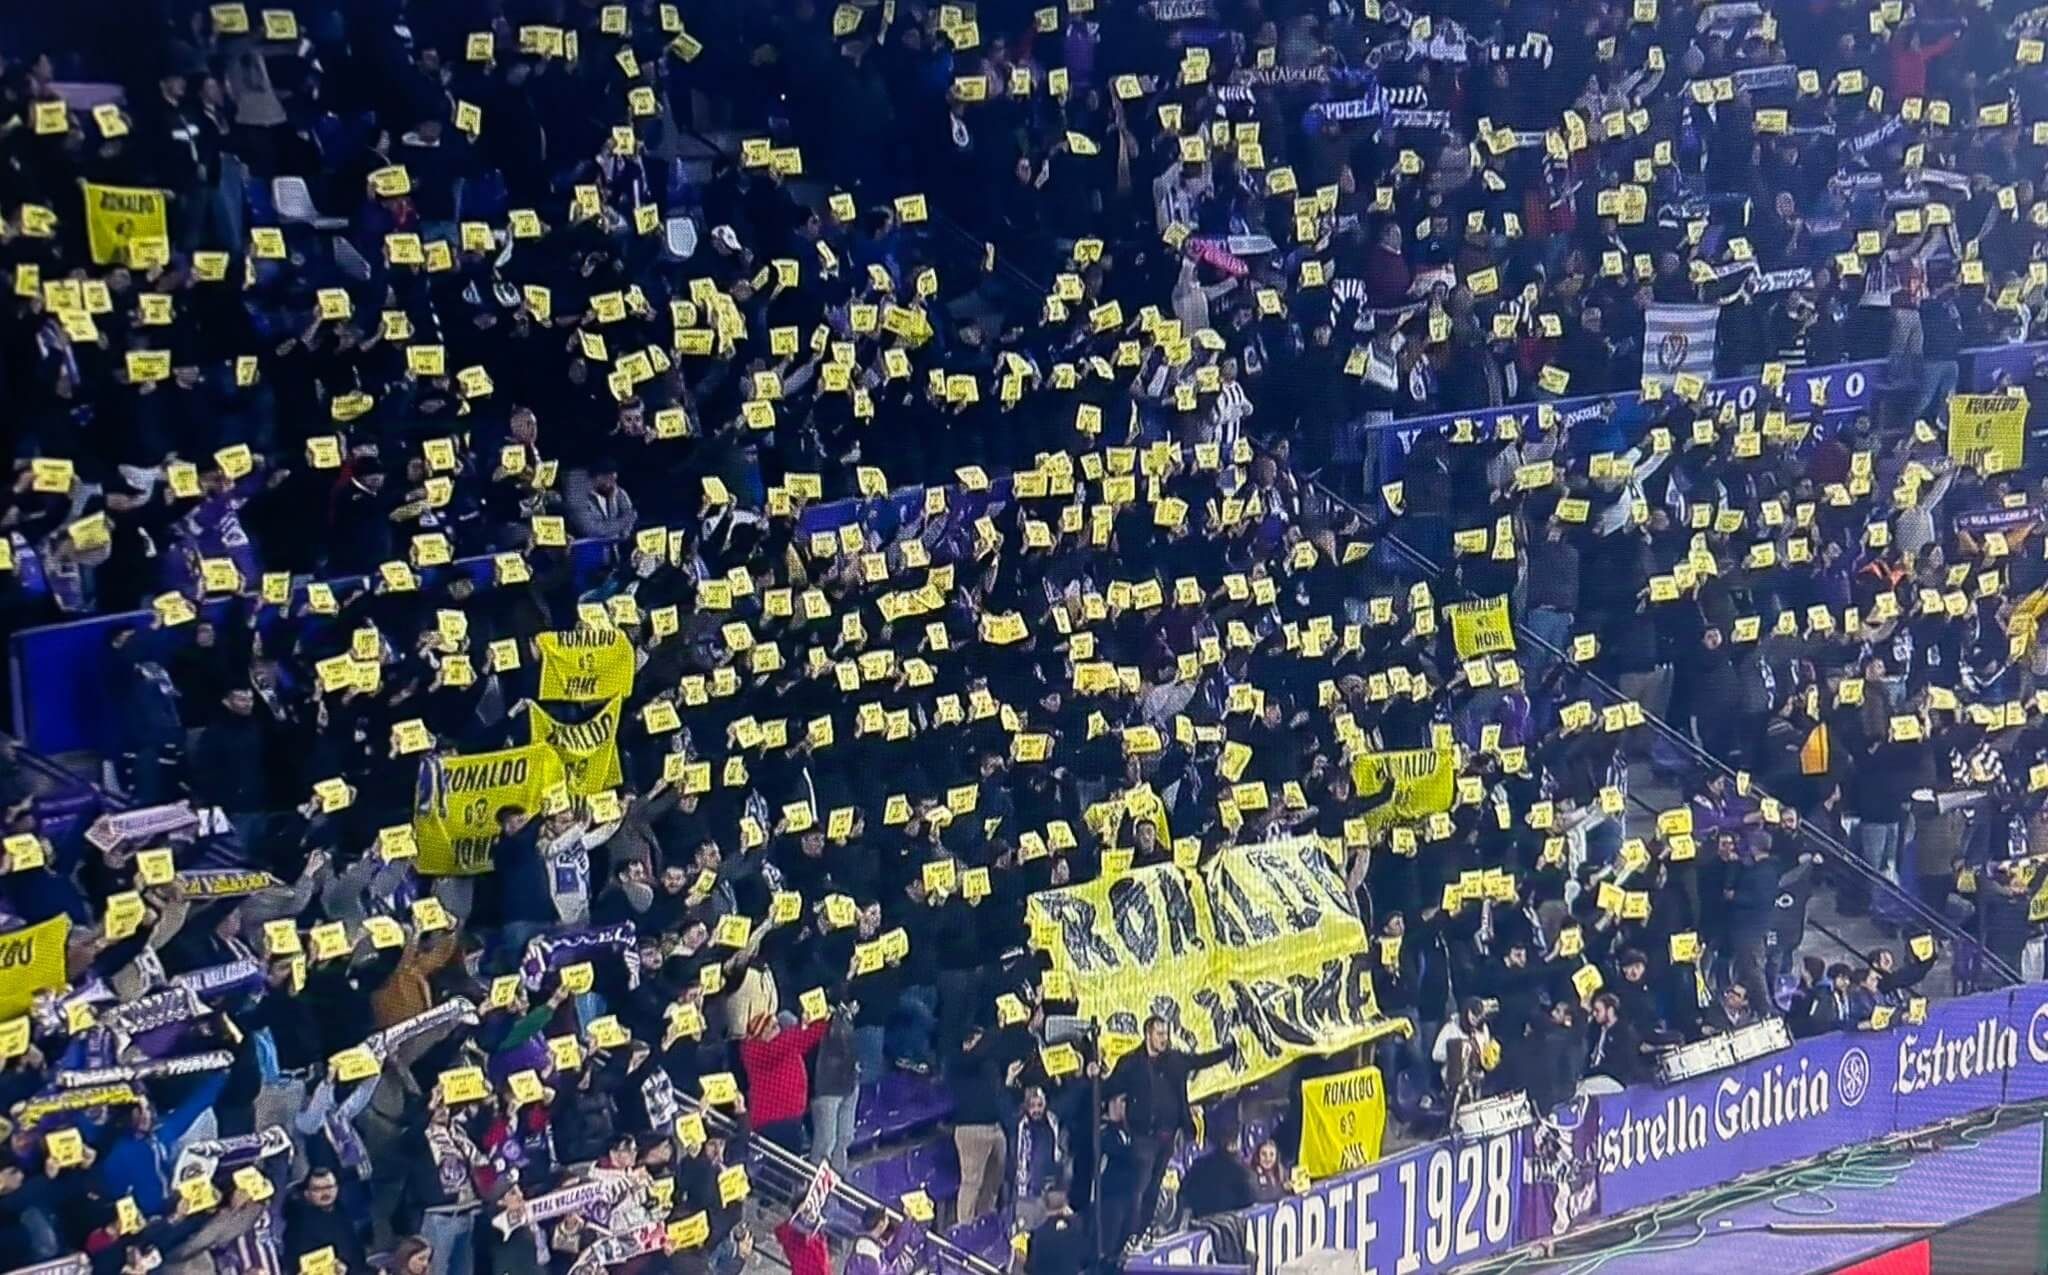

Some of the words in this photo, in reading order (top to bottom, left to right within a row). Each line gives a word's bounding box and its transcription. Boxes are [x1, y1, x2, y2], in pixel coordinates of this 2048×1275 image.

[557, 629, 617, 649] RONALDO
[1039, 846, 1360, 973] RONALDO
[1322, 1074, 1375, 1108] RONALDO
[1894, 1017, 2019, 1095] Estrella
[1714, 1056, 1830, 1141] Galicia
[1246, 1174, 1381, 1275] NORTE
[1397, 1136, 1513, 1273] 1928
